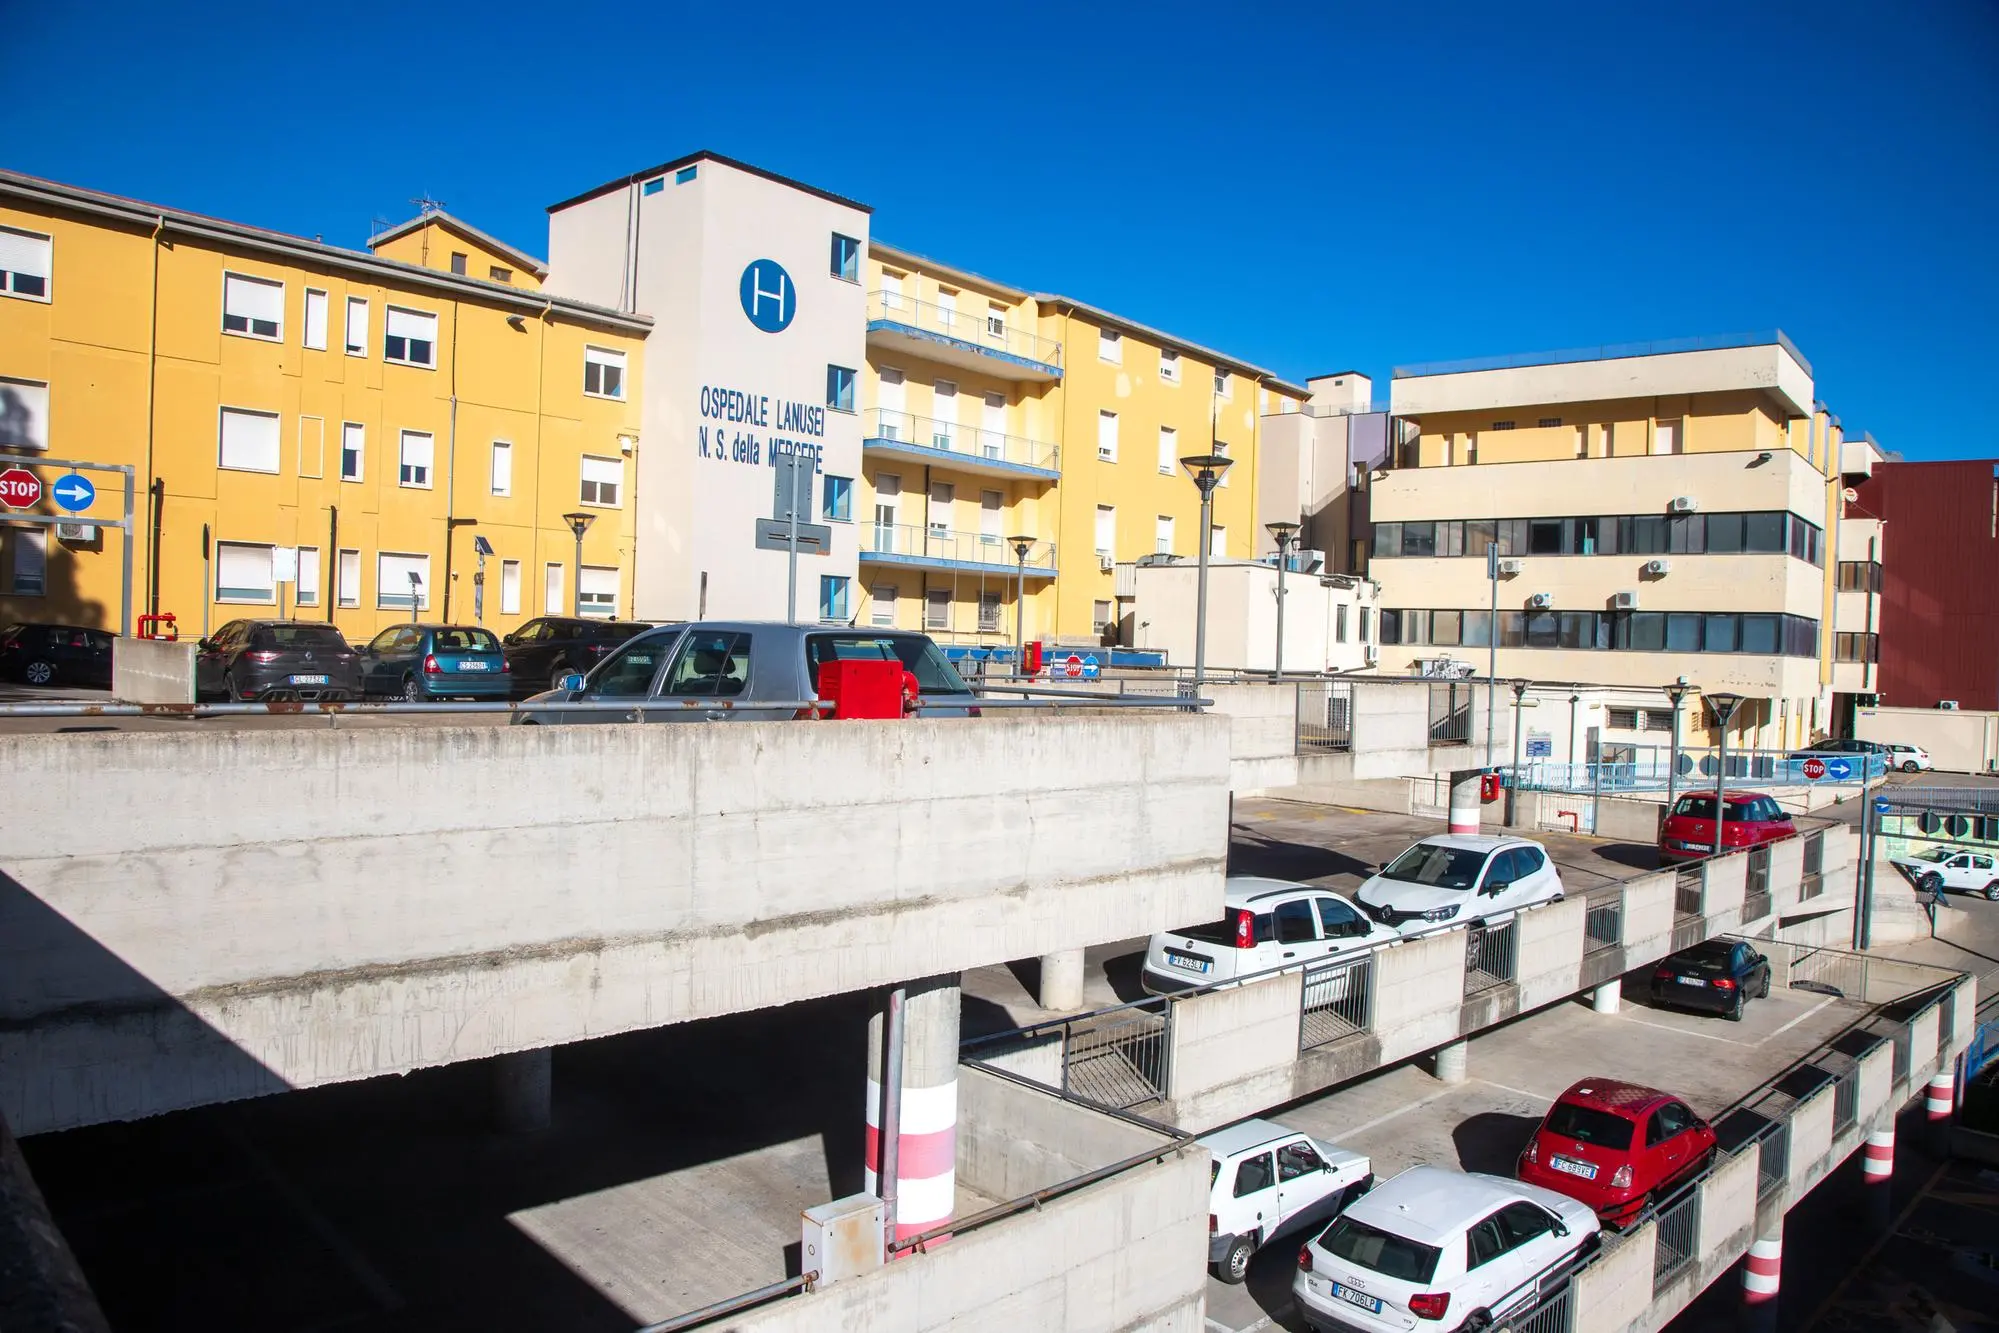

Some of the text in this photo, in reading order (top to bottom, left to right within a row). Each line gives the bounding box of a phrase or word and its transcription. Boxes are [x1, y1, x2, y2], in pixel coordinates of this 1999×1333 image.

[753, 267, 784, 322] H
[700, 385, 825, 437] OSPEDALE LANUSEI
[698, 425, 711, 459] N.
[716, 428, 727, 461] S.
[732, 431, 760, 465] della
[0, 480, 38, 497] STOP
[1804, 764, 1825, 775] STOP
[1556, 1160, 1567, 1169] FC
[1338, 1286, 1376, 1308] FK 706LP
